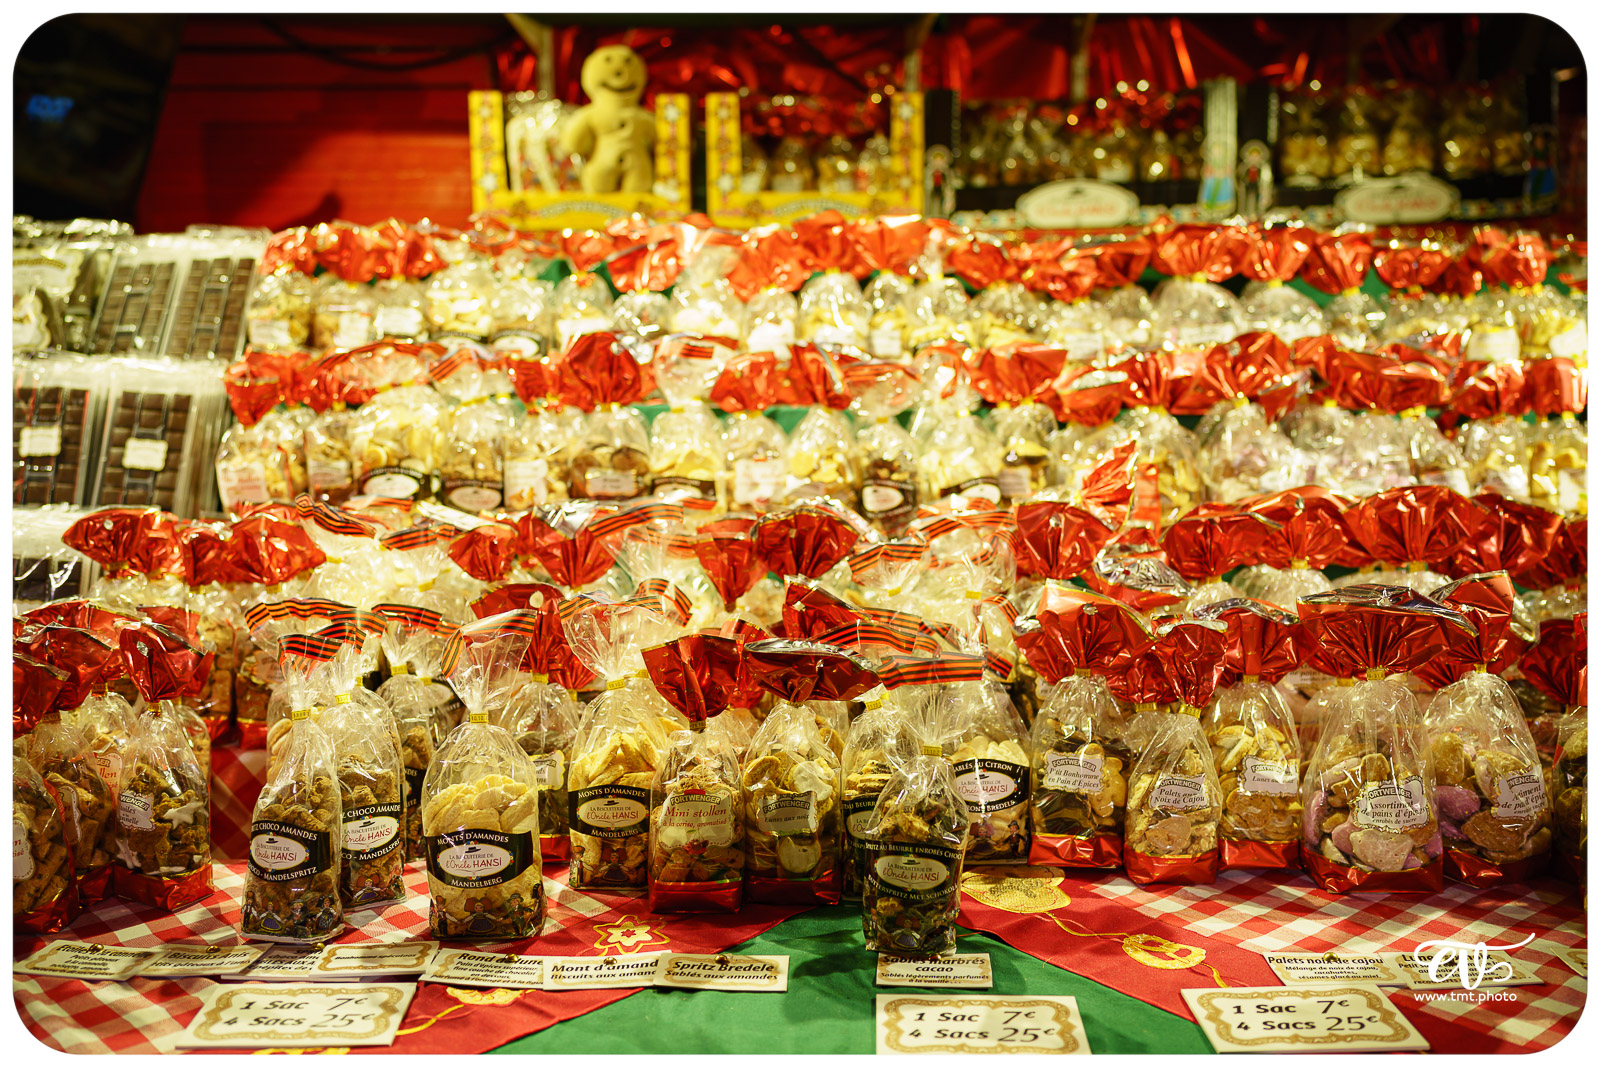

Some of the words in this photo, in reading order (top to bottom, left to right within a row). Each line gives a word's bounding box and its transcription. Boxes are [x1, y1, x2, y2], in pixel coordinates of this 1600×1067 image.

[985, 761, 1013, 771] CITRON
[578, 788, 603, 799] MONTS
[604, 786, 646, 798] D'AMANDES
[1160, 789, 1180, 797] Palets
[670, 794, 721, 805] FORTWENGER
[347, 807, 375, 818] CHOCO
[664, 807, 690, 817] Mini
[692, 805, 727, 818] stollen
[763, 800, 811, 814] FORTWENGER
[612, 810, 639, 819] HANSI
[1372, 810, 1393, 818] pains
[669, 819, 675, 827] la
[259, 822, 280, 831] CHOCO
[280, 825, 318, 841] AMANDES
[367, 826, 393, 840] HANSI
[465, 831, 509, 843] D'AMANDES
[591, 829, 639, 838] MANDELBERG
[889, 845, 913, 853] BEURRE
[915, 847, 943, 856] ENROBÉS
[270, 852, 297, 861] HANSI
[473, 857, 502, 868] HANSI
[264, 866, 318, 881] MANDELSPRITZ
[911, 872, 939, 881] HANSI
[451, 876, 503, 888] MANDELBERG
[458, 952, 497, 963] Rond
[1268, 956, 1304, 964] Palets
[1352, 957, 1384, 966] cajou
[552, 964, 594, 972] Mont
[673, 961, 716, 972] Spritz
[717, 962, 774, 972] Bredele
[551, 972, 593, 980] Biscuits
[665, 970, 701, 978] Sablés
[240, 1000, 252, 1010] 1
[263, 1000, 309, 1010] Sac
[1232, 1005, 1242, 1014] 1
[1256, 1003, 1297, 1014] Sac
[223, 1016, 237, 1026] 4
[249, 1016, 308, 1027] Sacs
[914, 1012, 925, 1022] 1
[938, 1012, 980, 1022] Sac
[1236, 1022, 1250, 1031] 4
[1263, 1020, 1316, 1031] Sacs
[908, 1030, 922, 1039] 4
[935, 1028, 989, 1040] Sacs
